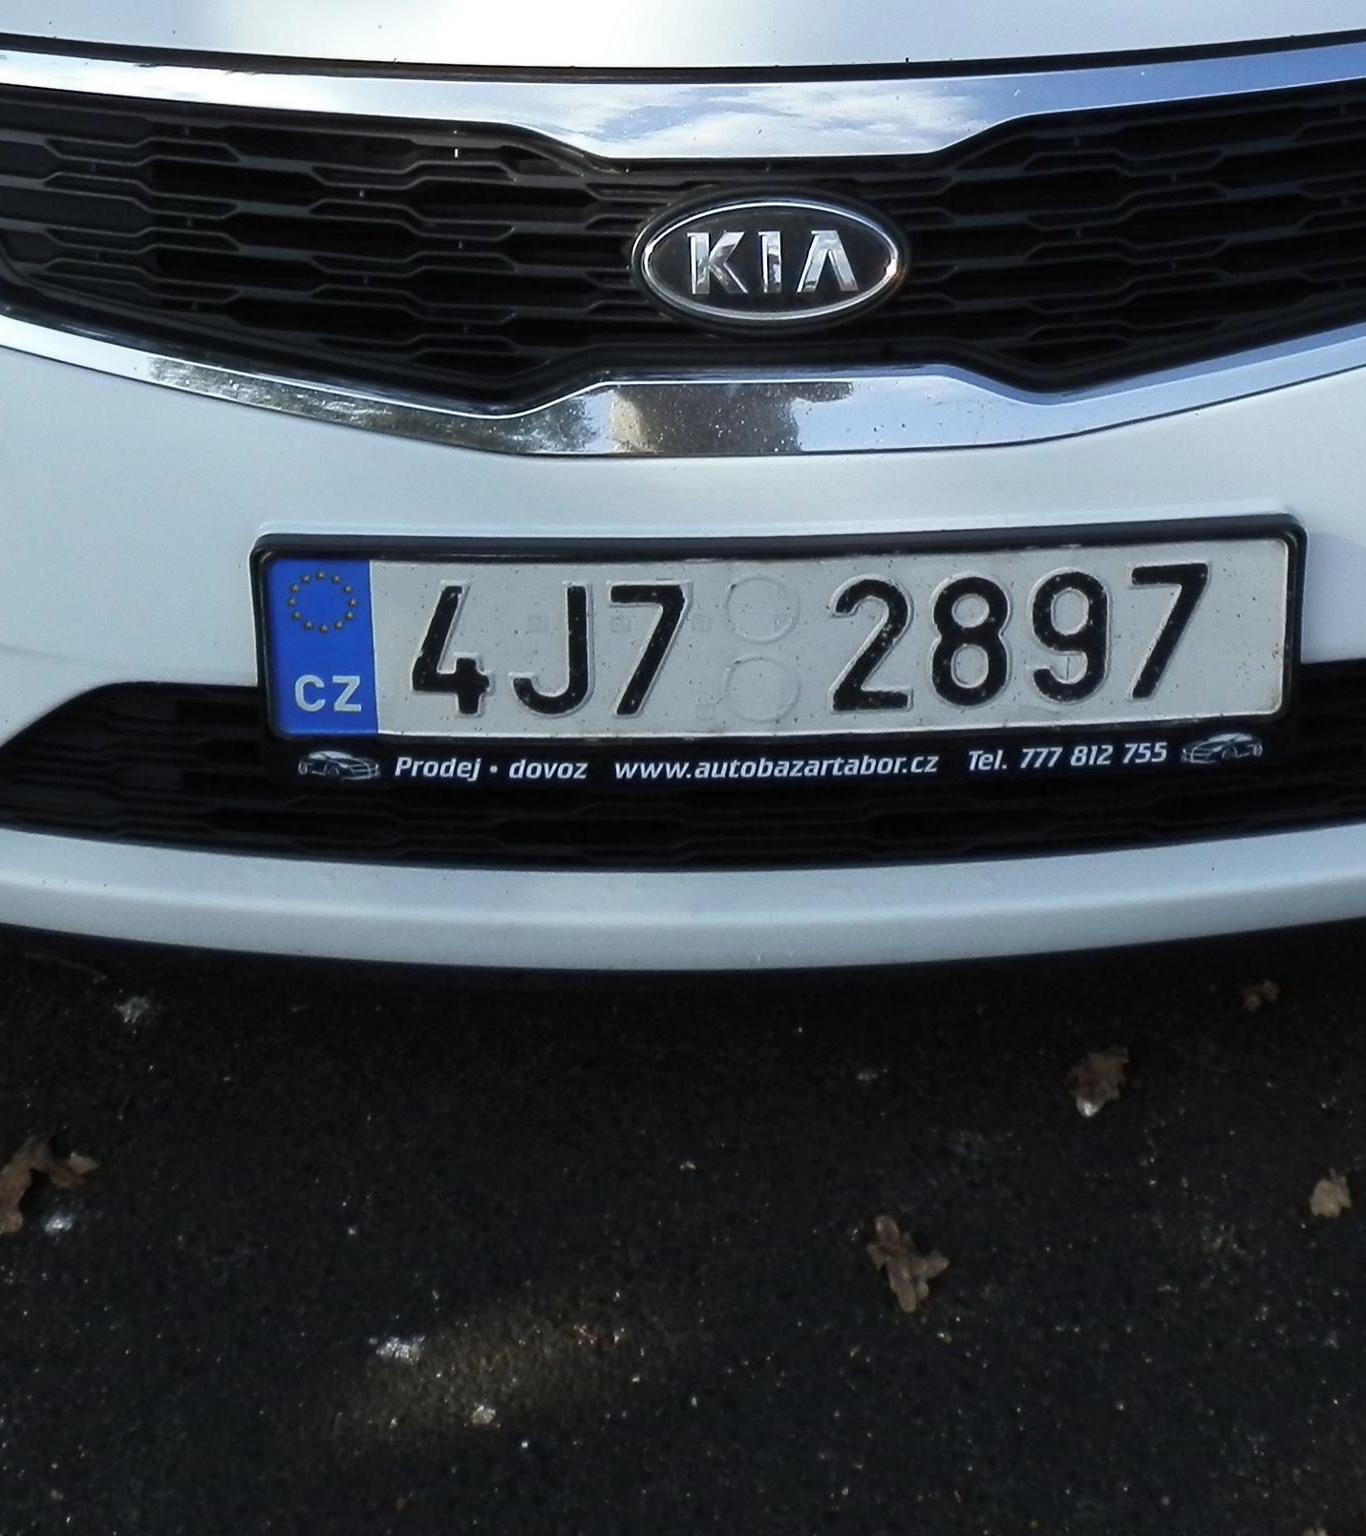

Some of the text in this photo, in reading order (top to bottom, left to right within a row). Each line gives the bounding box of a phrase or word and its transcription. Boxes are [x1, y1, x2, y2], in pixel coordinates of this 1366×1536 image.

[687, 230, 859, 295] KIA
[410, 563, 1212, 718] 4J7 2897
[294, 674, 362, 712] CZ
[394, 741, 1168, 781] Prodej dovoz www.autobazartabor.cz Tel. 777 812 755
